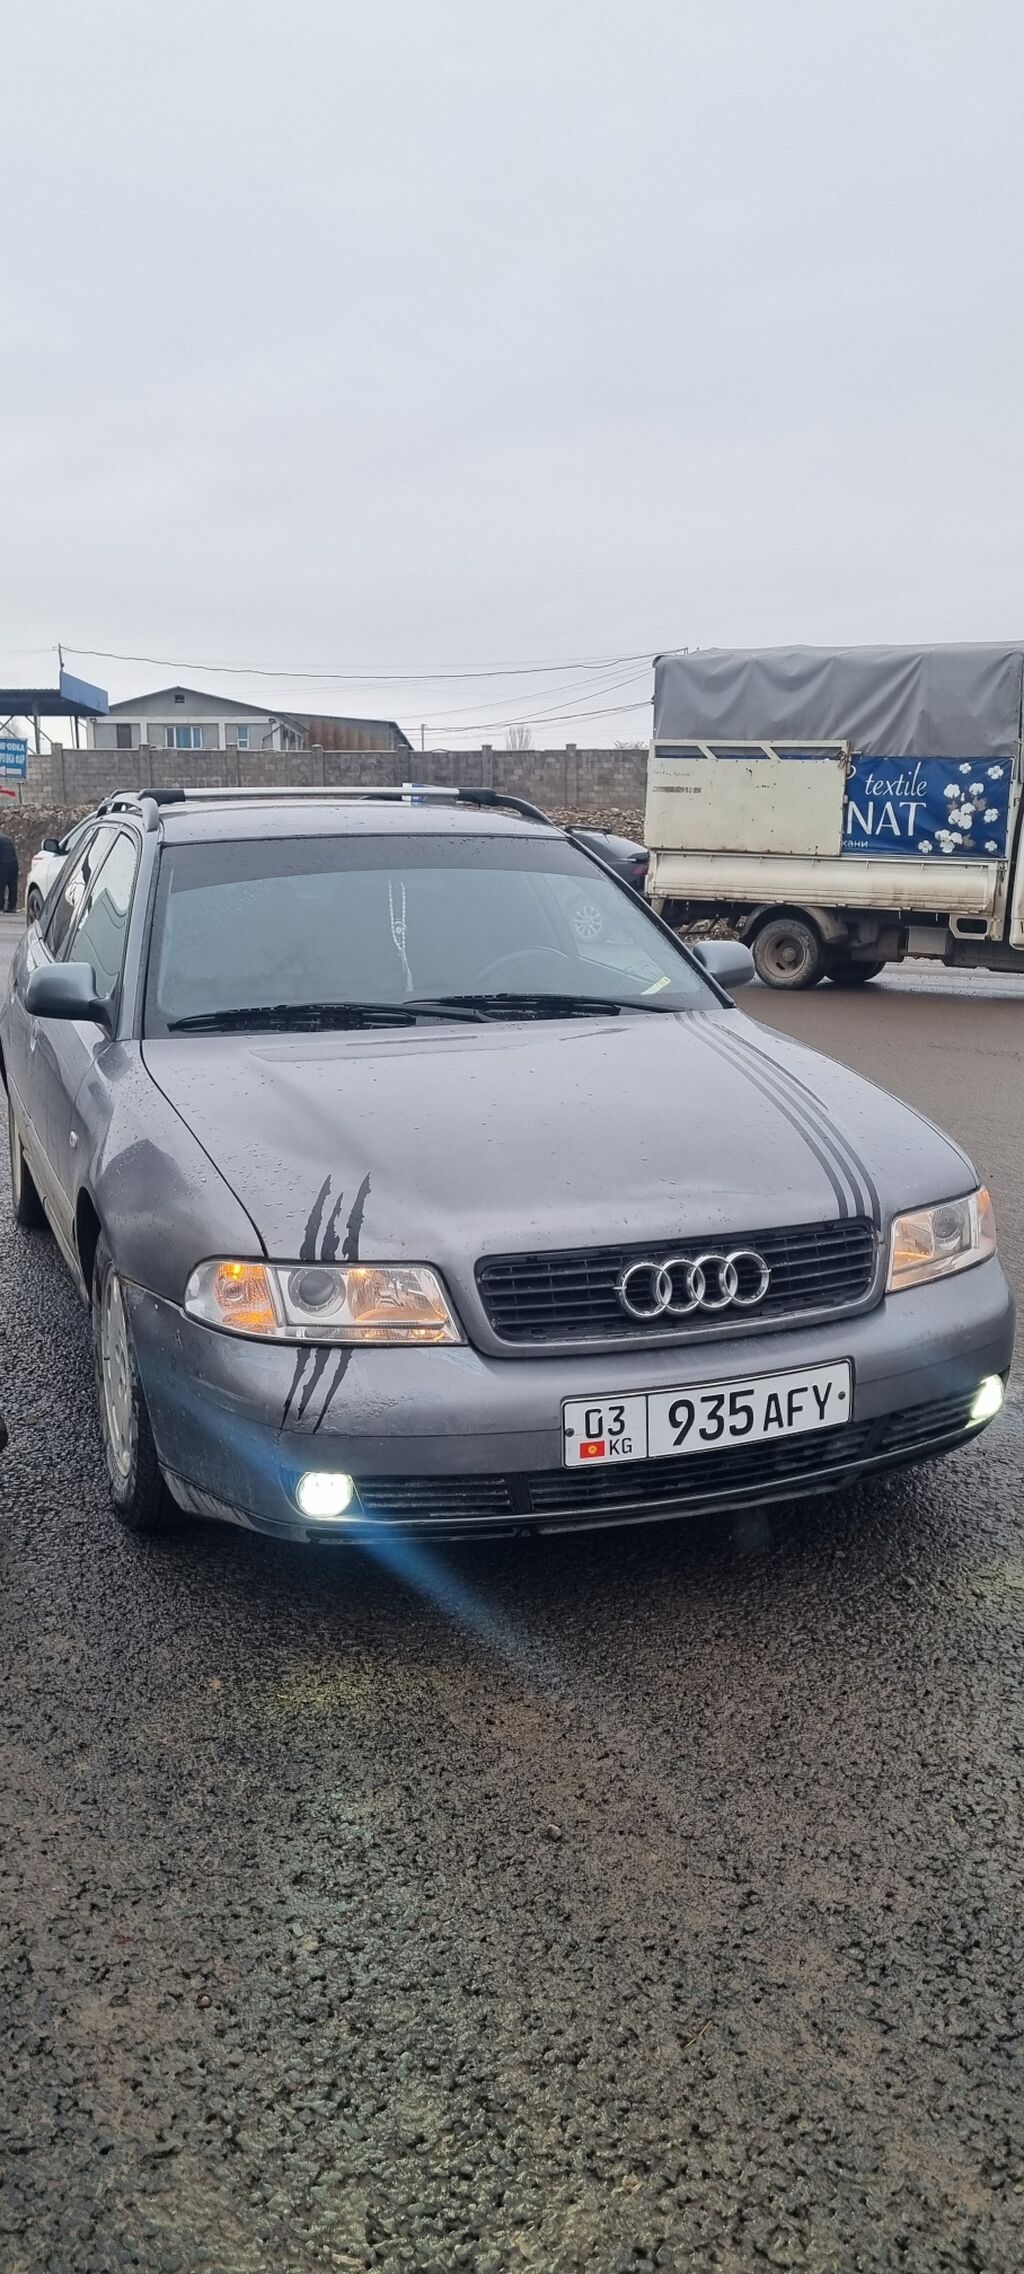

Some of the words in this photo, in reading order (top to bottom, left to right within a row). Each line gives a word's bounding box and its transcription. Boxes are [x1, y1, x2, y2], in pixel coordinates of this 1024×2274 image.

[865, 761, 927, 797] textile
[842, 801, 927, 836] NAT
[584, 1405, 625, 1439] 03
[609, 1437, 632, 1456] KG
